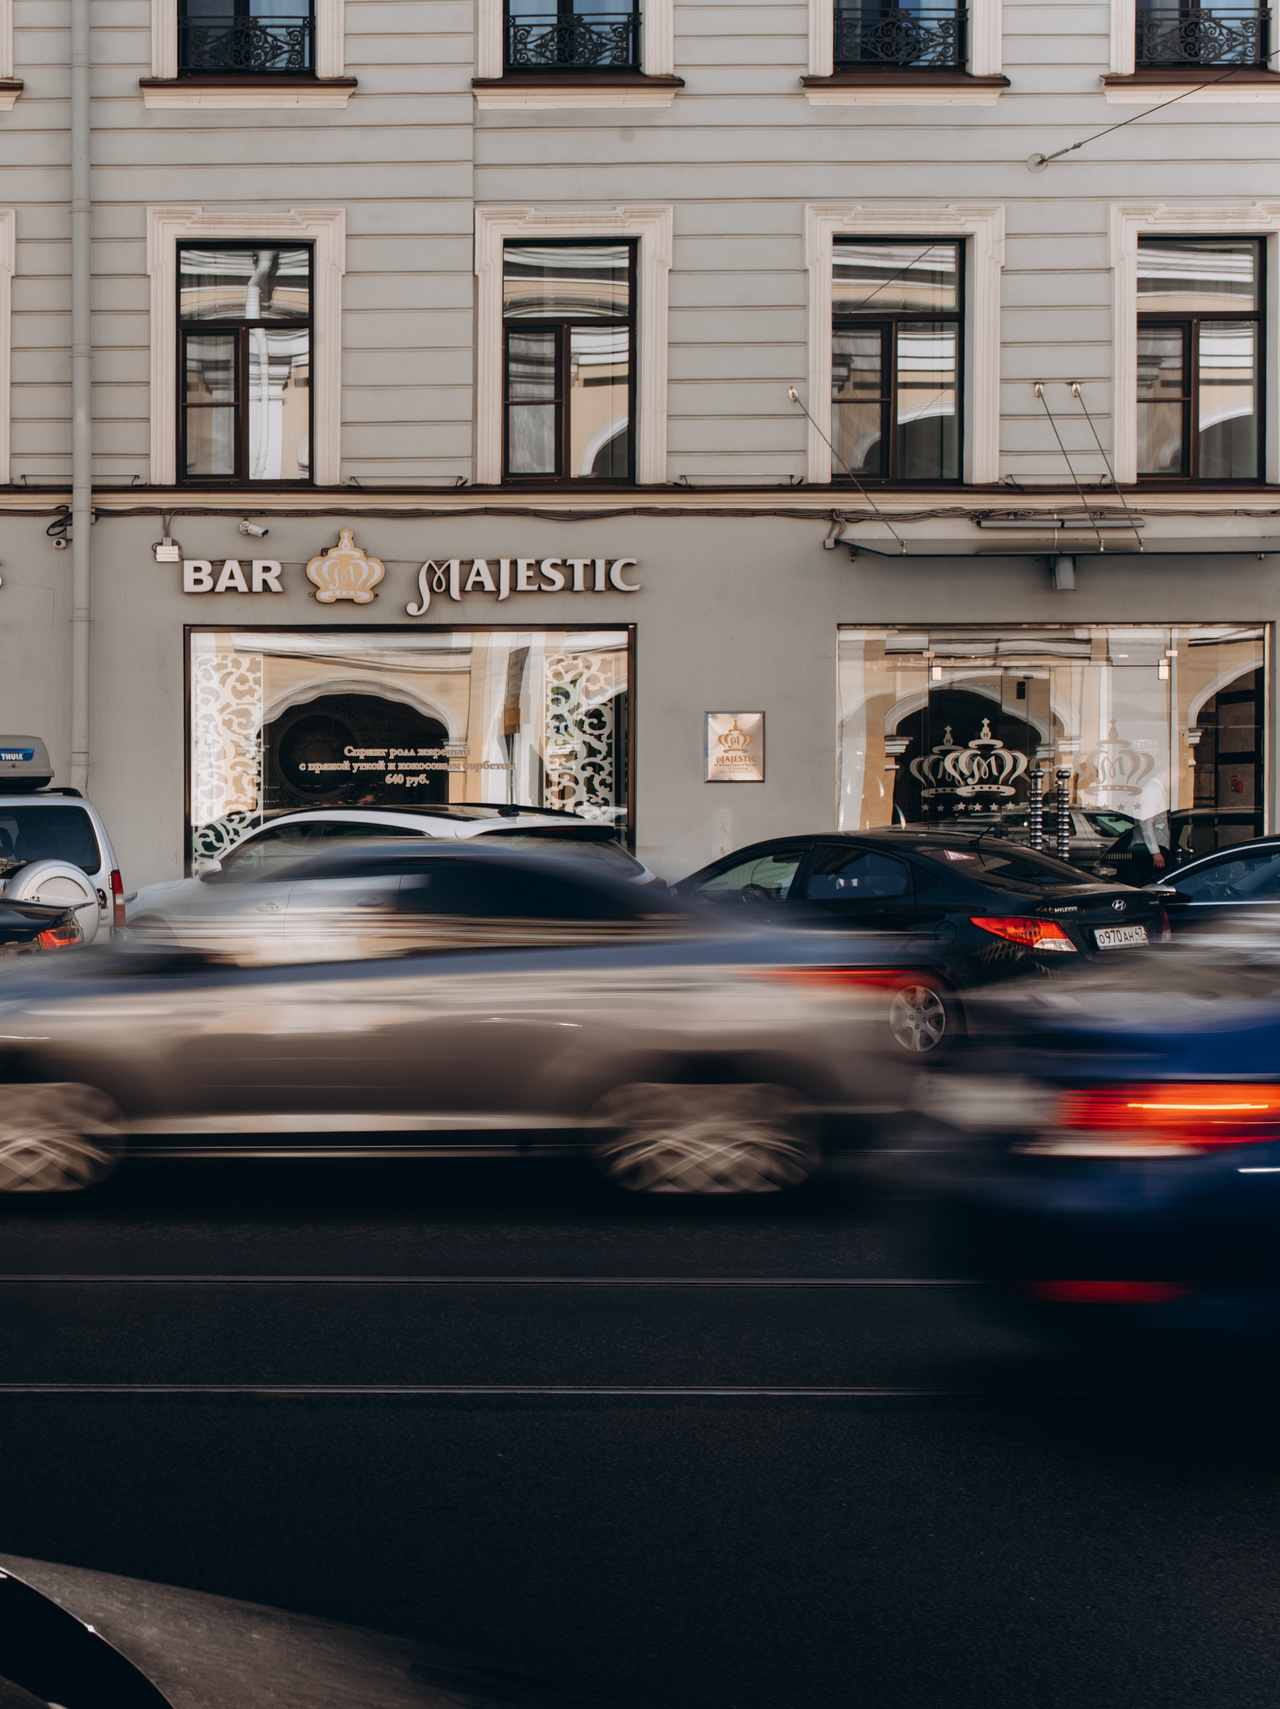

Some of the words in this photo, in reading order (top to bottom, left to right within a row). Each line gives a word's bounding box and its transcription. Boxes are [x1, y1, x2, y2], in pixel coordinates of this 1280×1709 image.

[183, 559, 284, 593] BAR
[406, 558, 641, 617] MAJESTIC
[0, 753, 23, 761] THULE
[344, 746, 388, 759] Спринг
[389, 748, 416, 759] ролл
[417, 746, 471, 759] жареный
[308, 760, 350, 774] пряной
[352, 760, 386, 774] уткой
[387, 762, 396, 770] и
[397, 762, 462, 771] кокосовым
[463, 760, 516, 773] сорбетом
[714, 755, 757, 767] MAJESTIC
[385, 773, 404, 784] 640
[405, 773, 430, 787] руб.
